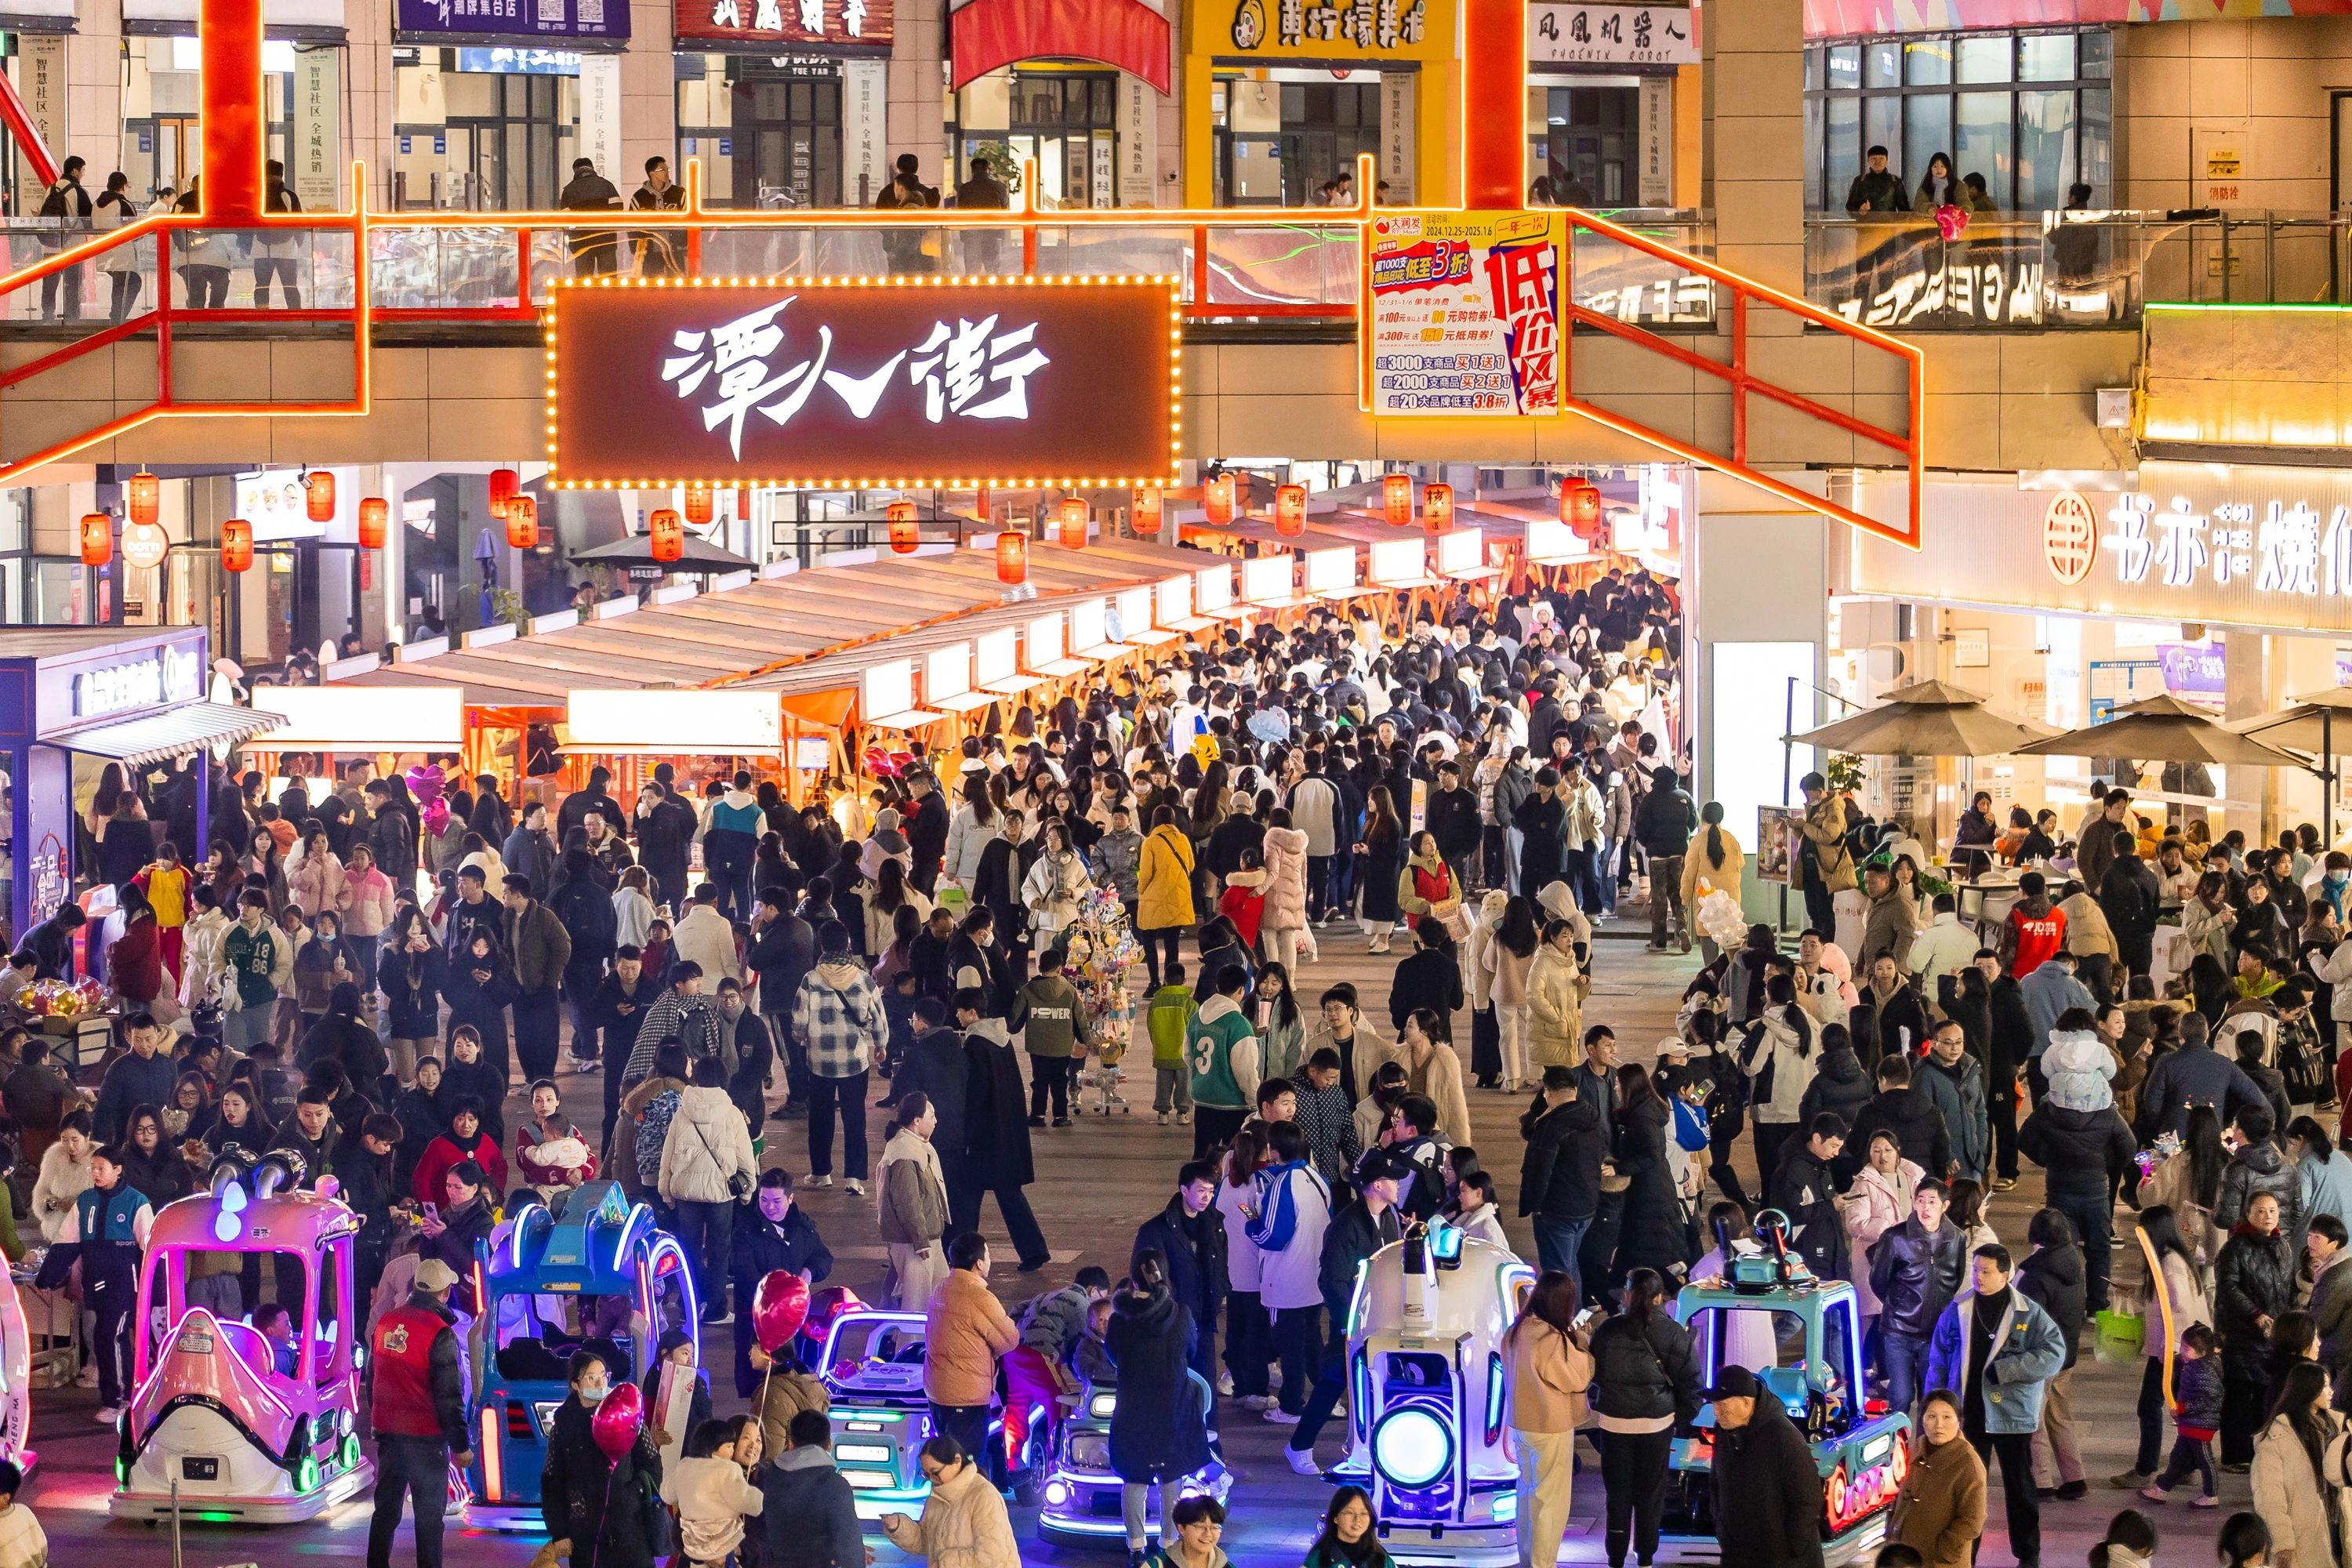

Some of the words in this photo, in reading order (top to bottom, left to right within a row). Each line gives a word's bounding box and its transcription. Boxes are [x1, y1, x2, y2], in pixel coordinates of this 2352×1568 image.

[1279, 0, 1426, 49] 黄柠檬美术
[1539, 10, 1686, 49] 凤凰机器人
[1551, 49, 1610, 60] PHOENIX
[1629, 49, 1671, 61] ROBOT
[36, 58, 48, 113] 智慧社区
[310, 66, 321, 117] 智慧社区
[595, 76, 605, 123] 智慧社区
[310, 122, 322, 173] 全城热销
[2209, 186, 2239, 201] 消防栓
[1391, 216, 1421, 228] 大润发
[1426, 226, 1492, 237] 2024.12.25-2025.1.6
[1498, 215, 1544, 234] 一年一次
[1375, 257, 1407, 273] 超1000支
[1414, 297, 1450, 307] 单笔消费
[661, 294, 1051, 463] 潭人街
[2101, 492, 2209, 586] 书亦
[253, 941, 270, 958] 18
[1030, 1007, 1071, 1020] POWER
[1194, 1036, 1215, 1076] 3
